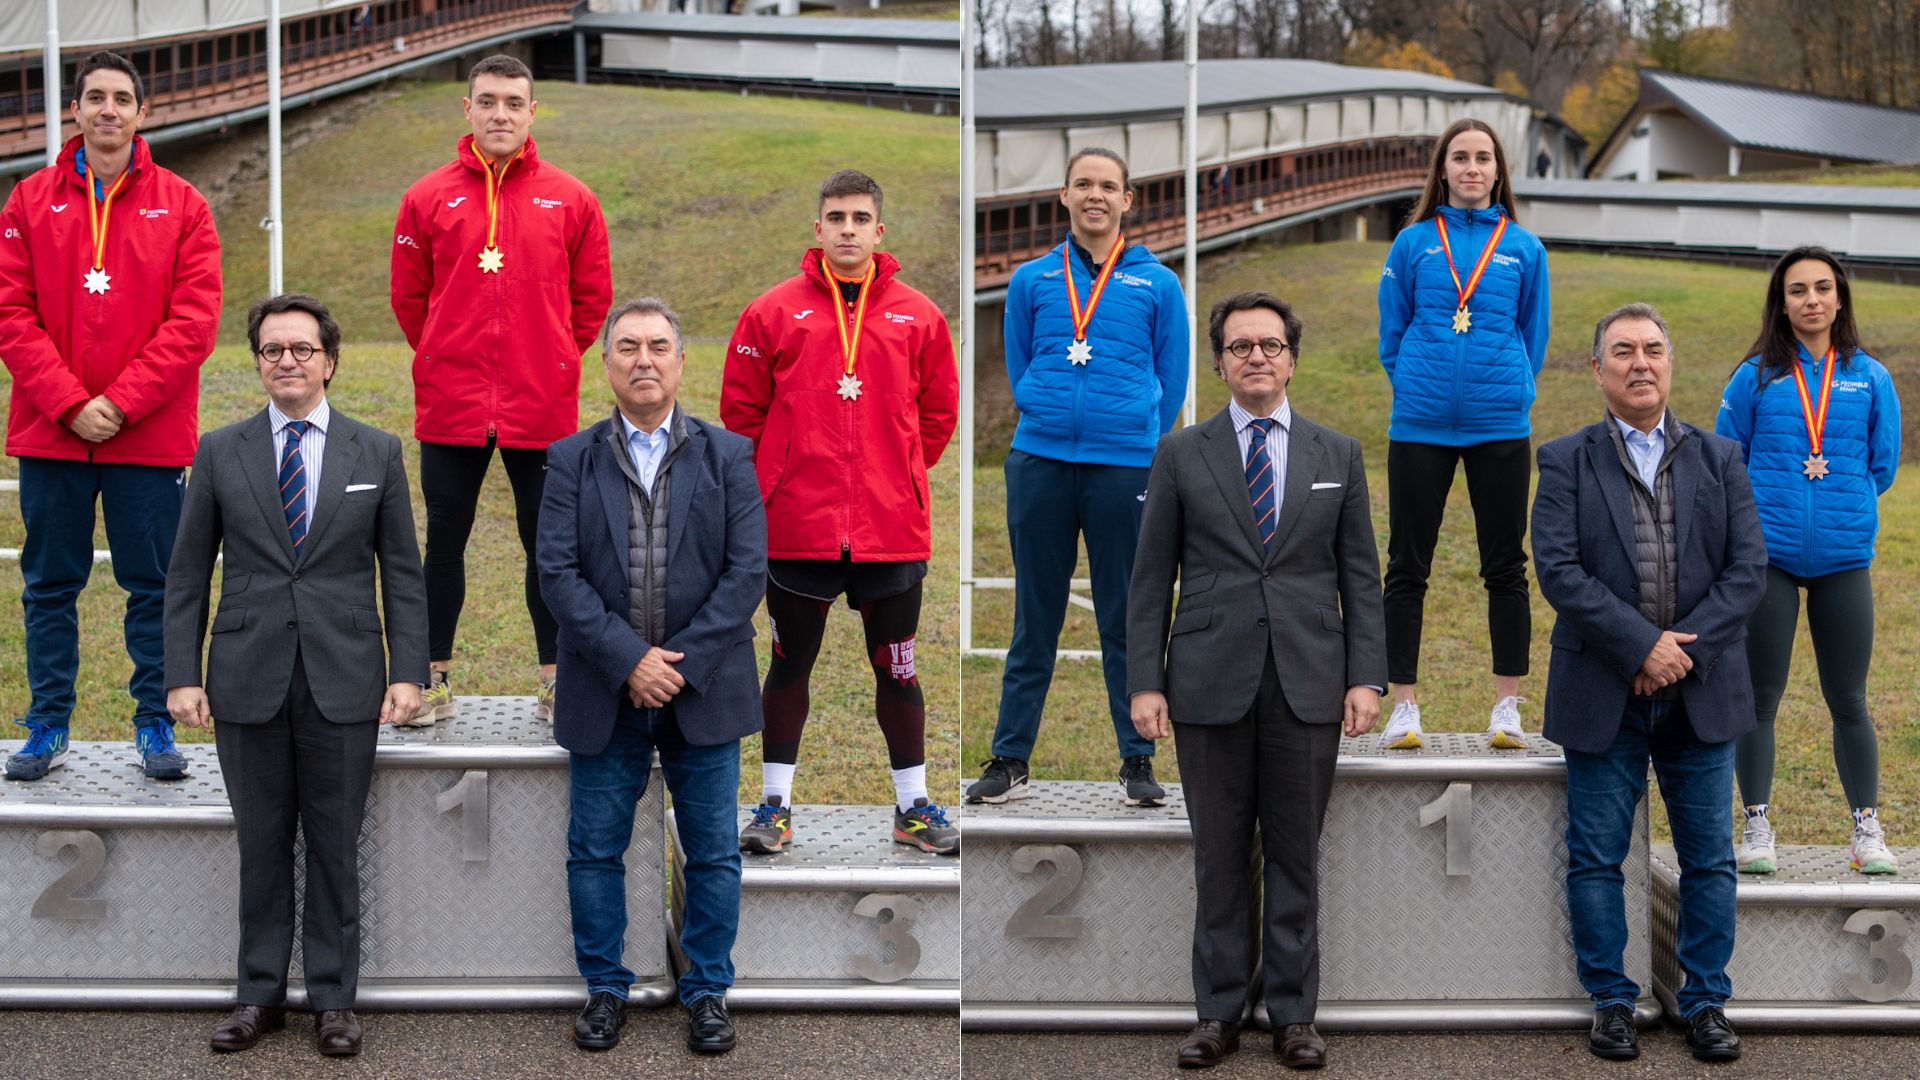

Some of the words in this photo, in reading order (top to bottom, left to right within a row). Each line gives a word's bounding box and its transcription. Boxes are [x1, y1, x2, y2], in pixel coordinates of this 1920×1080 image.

[436, 770, 488, 861] 1
[1420, 783, 1472, 876] 1
[30, 829, 107, 920] 2
[1005, 844, 1083, 938] 2
[850, 892, 921, 983] 3
[1842, 908, 1913, 1002] 3
